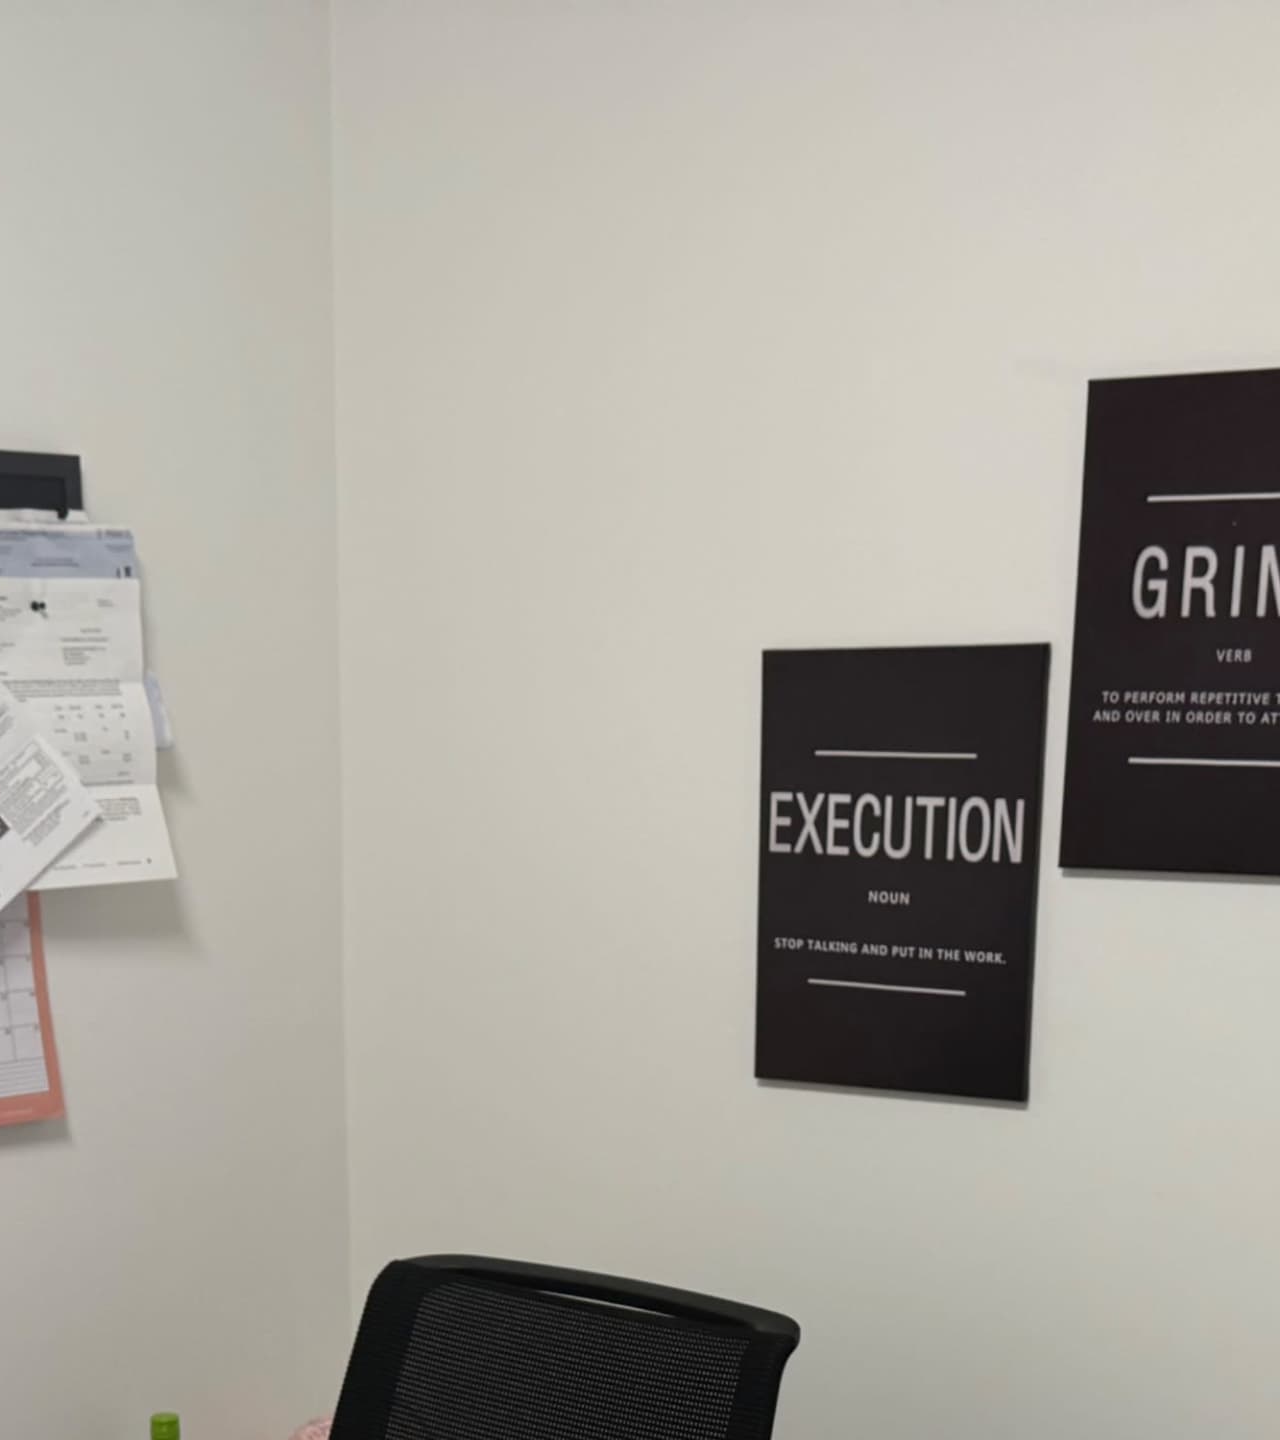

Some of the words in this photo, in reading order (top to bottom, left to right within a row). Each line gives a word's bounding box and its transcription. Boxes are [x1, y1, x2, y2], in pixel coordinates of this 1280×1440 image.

[1216, 649, 1253, 663] VERB
[1102, 691, 1119, 704] TO
[1124, 691, 1185, 705] PERFORM
[1190, 692, 1270, 705] REPETITIVE
[1093, 710, 1121, 723] AND
[1125, 710, 1160, 723] OVER
[1166, 711, 1181, 723] IN
[1186, 711, 1232, 725] ORDER
[1238, 712, 1256, 725] TO
[769, 791, 1025, 864] EXECUTION
[868, 891, 911, 905] NOUN
[774, 937, 805, 950] STOP
[807, 939, 858, 954] TALKING
[861, 943, 888, 956] AND
[892, 946, 915, 958] PUT
[919, 948, 933, 959] IN
[937, 949, 960, 961] THE
[965, 951, 1007, 965] WORK.
